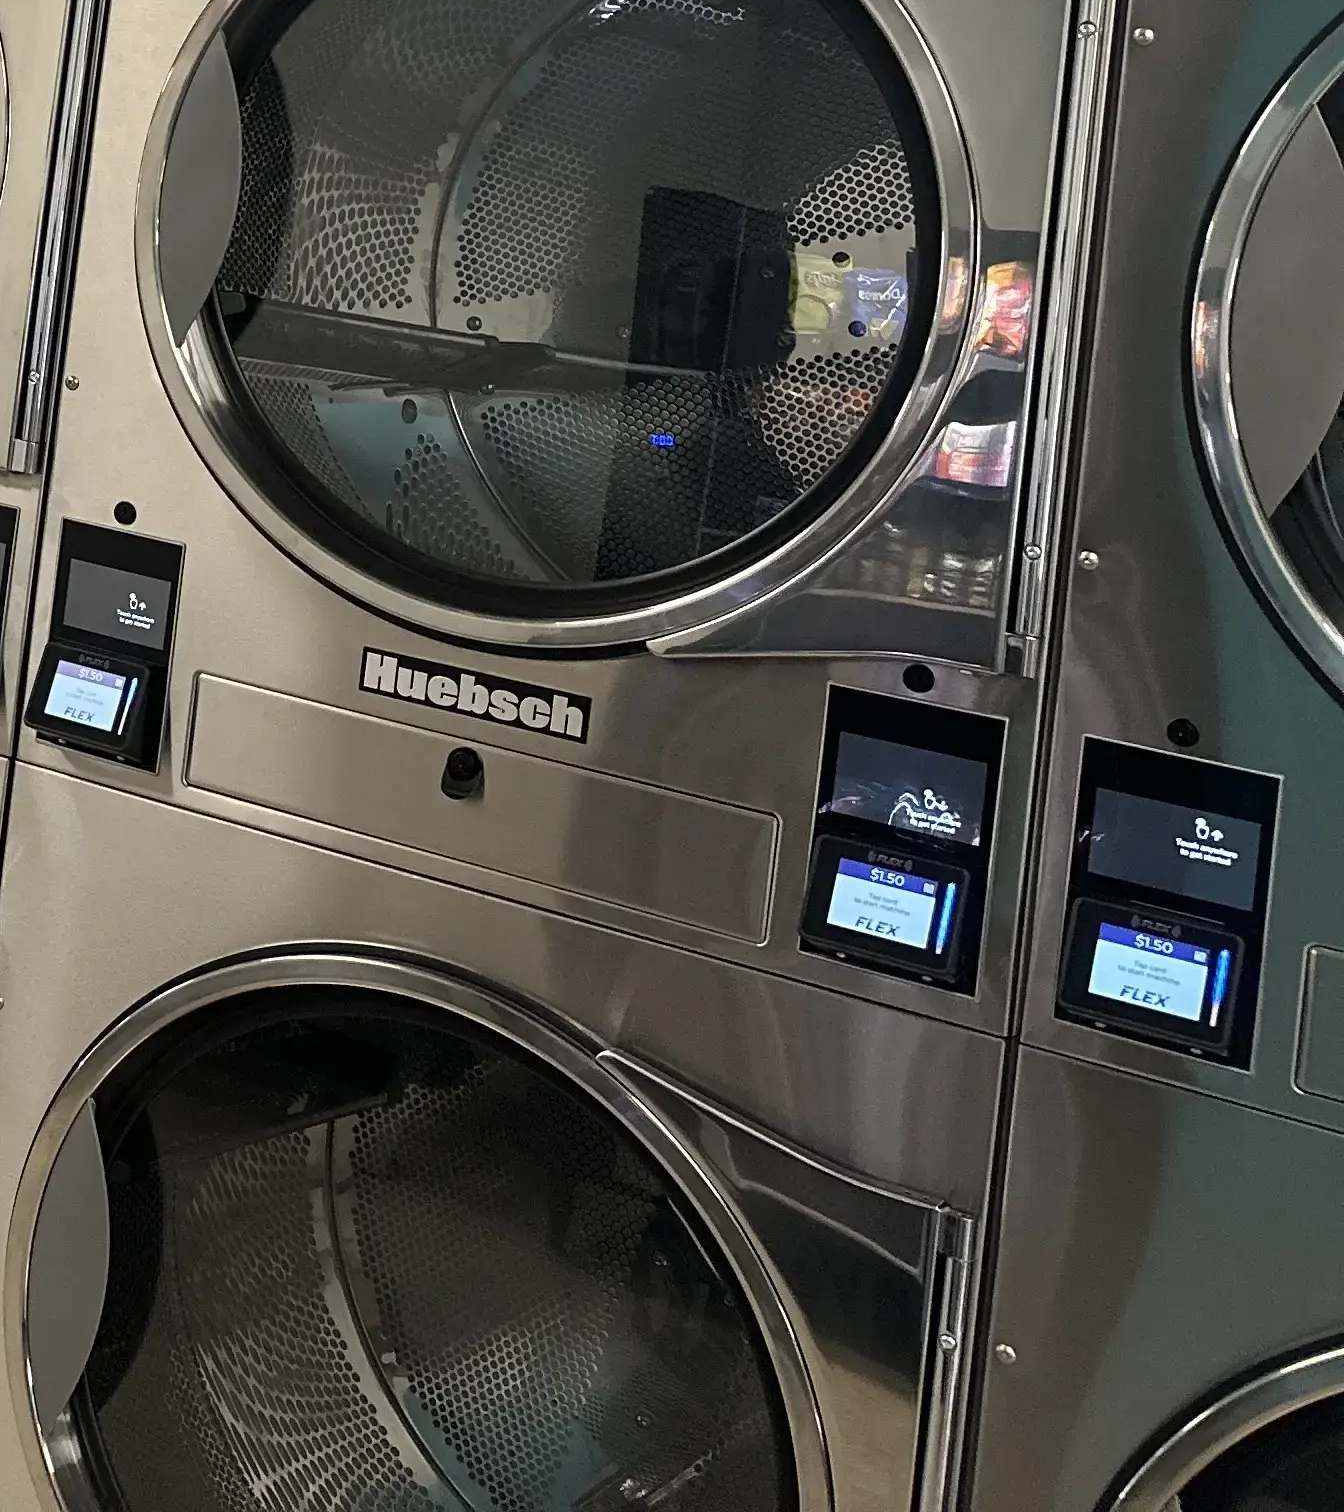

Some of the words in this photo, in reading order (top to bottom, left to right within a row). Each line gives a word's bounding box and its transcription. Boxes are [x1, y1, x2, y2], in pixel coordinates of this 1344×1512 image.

[363, 651, 584, 738] Huebsch
[64, 706, 96, 723] FLEX
[869, 867, 905, 887] $1.50
[854, 916, 901, 937] FLEX
[1134, 933, 1173, 954] $1.50
[1120, 984, 1171, 1008] FLEX
